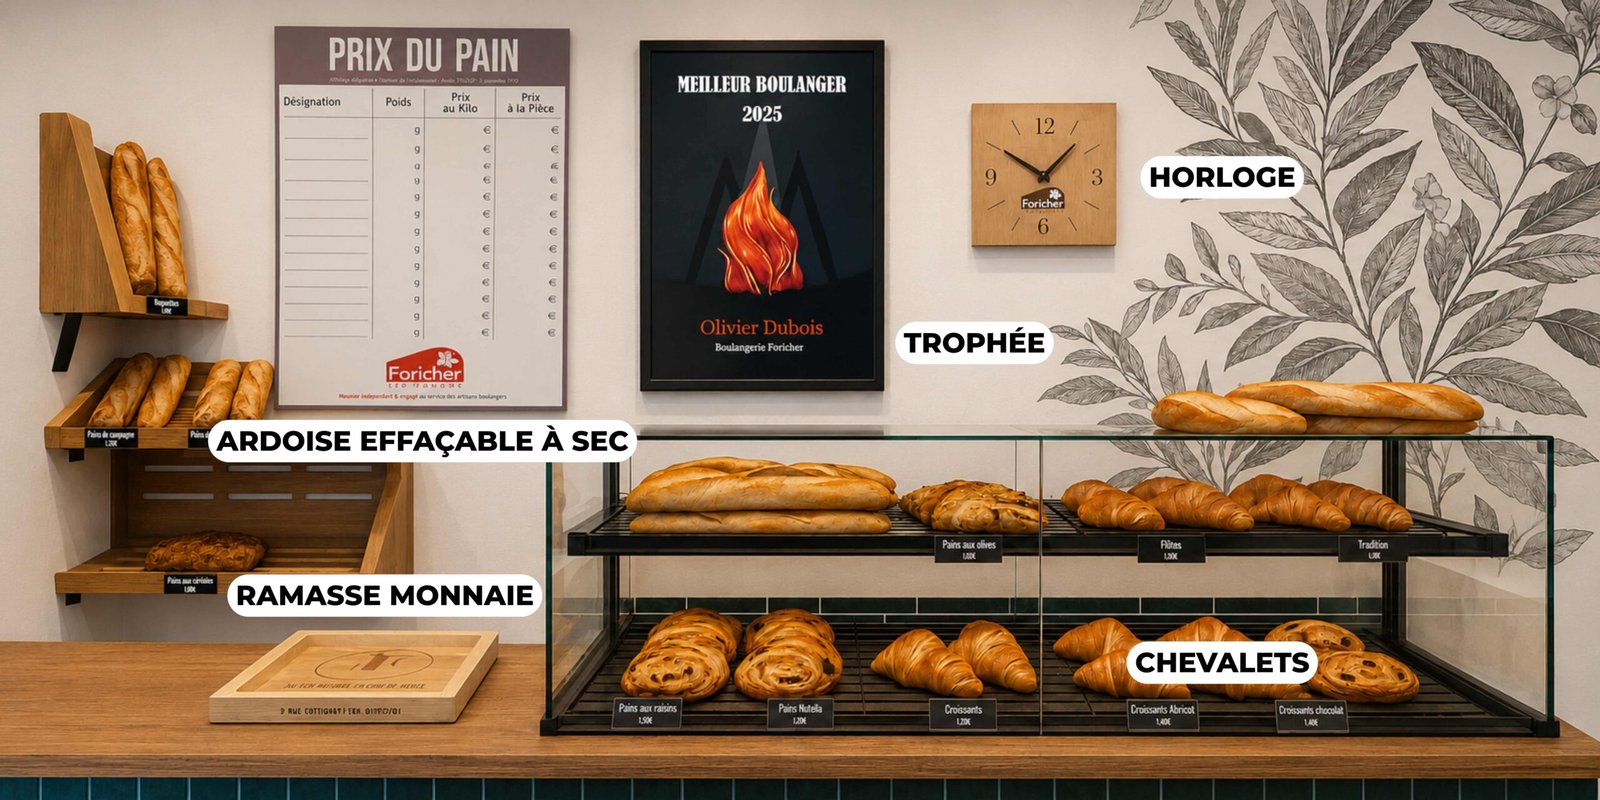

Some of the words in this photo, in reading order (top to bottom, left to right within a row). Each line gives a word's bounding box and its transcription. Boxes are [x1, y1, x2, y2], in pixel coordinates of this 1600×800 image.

[329, 37, 393, 71] PRIX
[406, 38, 443, 72] DU
[455, 38, 519, 72] PAIN
[677, 75, 751, 93] MEILLEUR
[755, 75, 847, 93] BOULANGER
[283, 95, 341, 107] Désignation
[385, 96, 412, 107] Poids
[451, 92, 471, 102] Prix
[521, 92, 541, 102] Prix
[443, 105, 455, 113] au
[458, 102, 478, 113] Kilo
[507, 103, 513, 113] à
[516, 103, 525, 113] la
[528, 102, 554, 113] Pièce
[742, 105, 783, 122] 2025
[1035, 117, 1055, 135] 12
[985, 168, 997, 186] 9
[1091, 168, 1103, 186] 3
[1022, 198, 1064, 209] Foricher
[1038, 218, 1049, 235] 6
[700, 319, 759, 335] Olivier
[763, 319, 824, 335] Dubois
[715, 343, 766, 354] Boulangerie
[767, 343, 804, 351] Foricher
[389, 366, 462, 381] Foricher
[943, 539, 961, 549] Pains
[976, 540, 996, 549] olives
[1160, 540, 1182, 549] Flûtes
[1358, 540, 1388, 549] Tradition
[619, 703, 638, 712] Pains
[653, 703, 677, 712] raisins
[779, 703, 797, 713] Pains
[945, 704, 983, 714] Croissants
[1131, 704, 1168, 714] Croissants
[1169, 704, 1195, 714] Abricot
[1279, 705, 1314, 714] Croissants
[1315, 705, 1344, 714] chocolat
